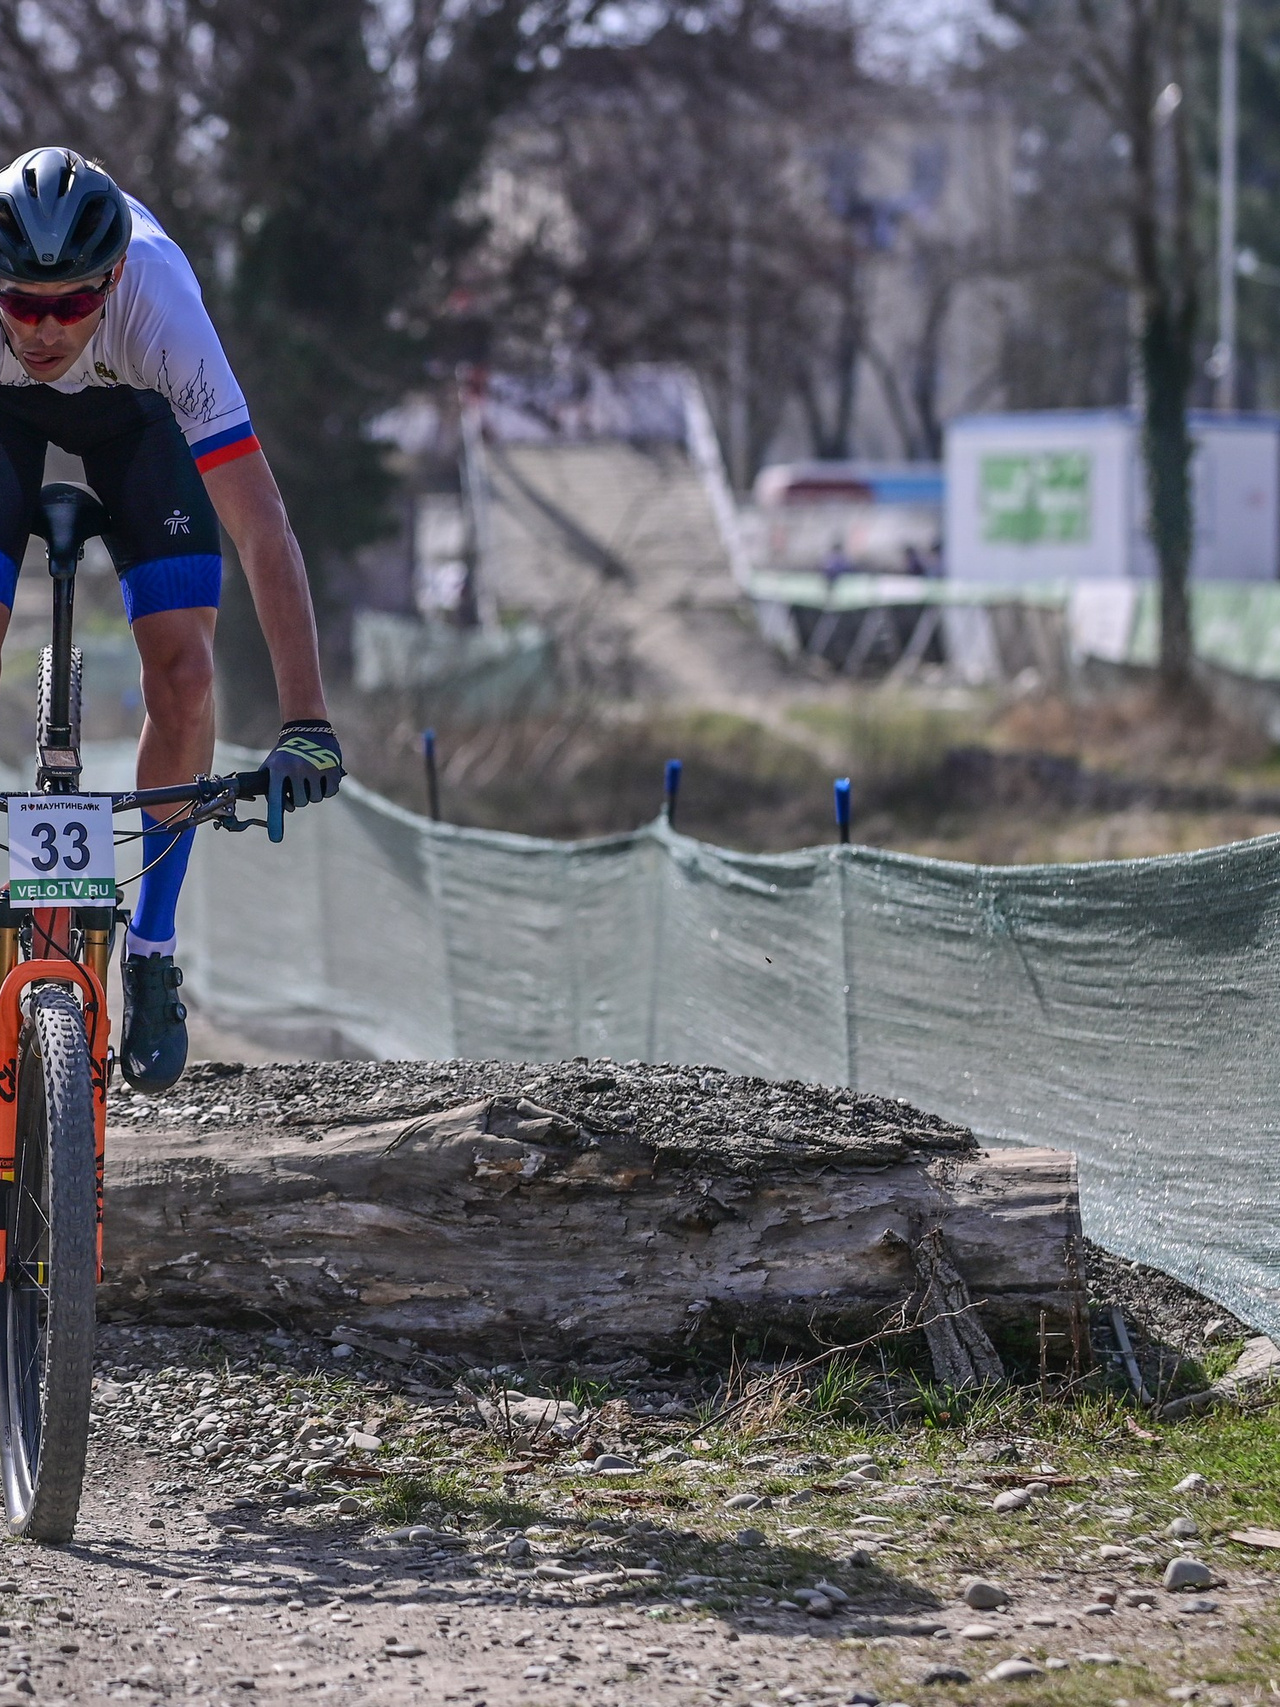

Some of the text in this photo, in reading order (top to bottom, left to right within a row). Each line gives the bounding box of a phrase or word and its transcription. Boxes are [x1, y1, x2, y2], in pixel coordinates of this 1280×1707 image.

[35, 802, 100, 811] МАУНТИНБАЙК
[31, 822, 91, 871] 33
[17, 881, 109, 897] VELOTV.RU
